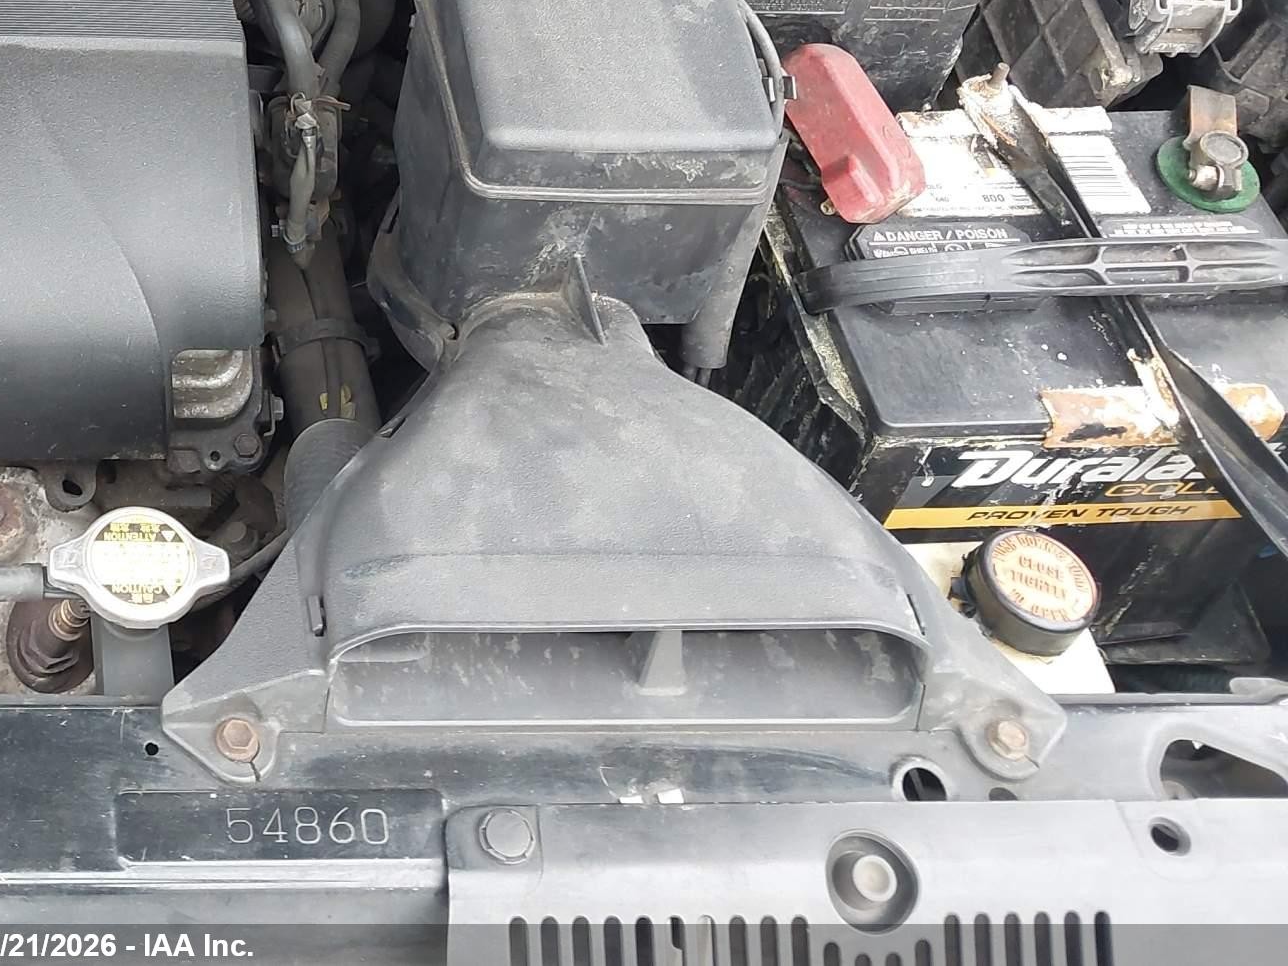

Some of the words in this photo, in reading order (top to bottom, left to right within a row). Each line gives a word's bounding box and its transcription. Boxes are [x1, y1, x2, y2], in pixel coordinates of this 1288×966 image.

[885, 230, 943, 242] DANGER
[955, 228, 1008, 240] POISON
[950, 447, 1206, 488] Durala
[1104, 482, 1220, 498] GOL
[967, 508, 1088, 522] PROVEN
[1097, 505, 1194, 518] TOUGH
[103, 531, 157, 542] ATTENTION
[1017, 555, 1064, 580] CLOSE
[111, 584, 164, 595] CAUTION
[1009, 569, 1067, 602] TIGHTLY
[225, 806, 390, 845] 54860
